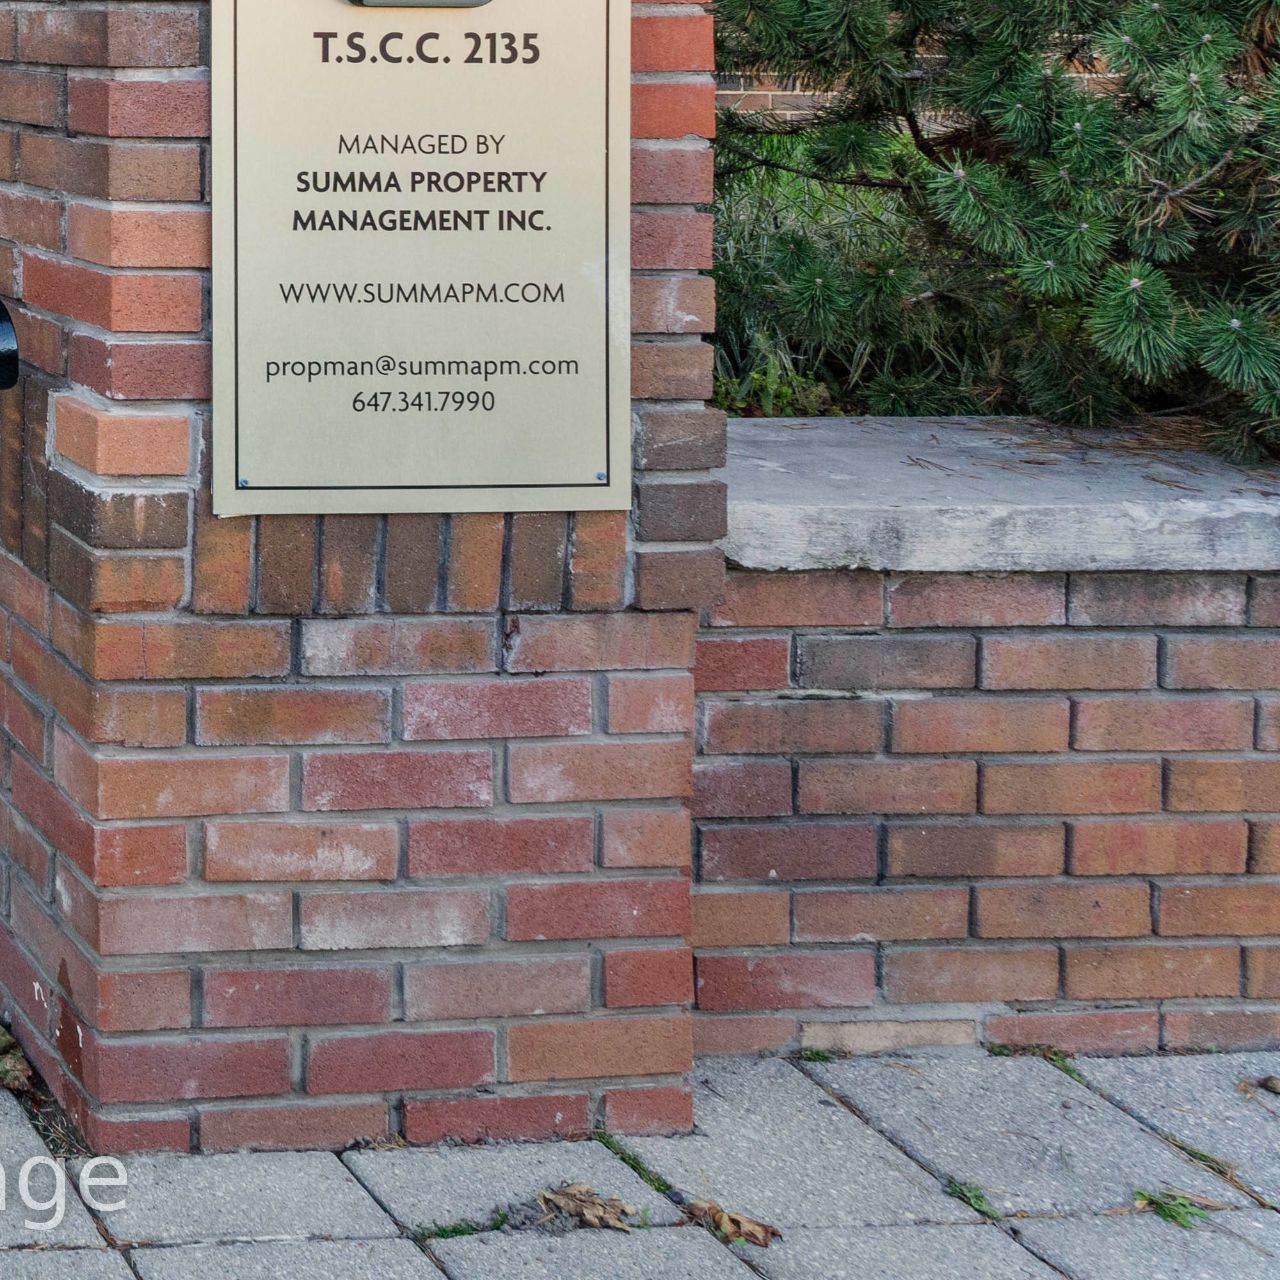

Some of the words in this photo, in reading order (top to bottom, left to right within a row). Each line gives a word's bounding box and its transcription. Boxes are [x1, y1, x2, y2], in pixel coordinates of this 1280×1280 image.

[313, 32, 451, 64] T.S.C.C.
[463, 31, 541, 65] 2135
[337, 134, 468, 155] MANAGED
[476, 134, 506, 155] BY
[296, 171, 402, 193] SUMMA
[410, 171, 548, 193] PROPERTY
[292, 210, 489, 231] MANAGEMENT
[498, 210, 552, 231] INC.
[279, 282, 565, 304] WWW.SUMMAPM.COM
[266, 354, 579, 383] propman@summapm.com
[351, 391, 495, 412] 647.341.7990
